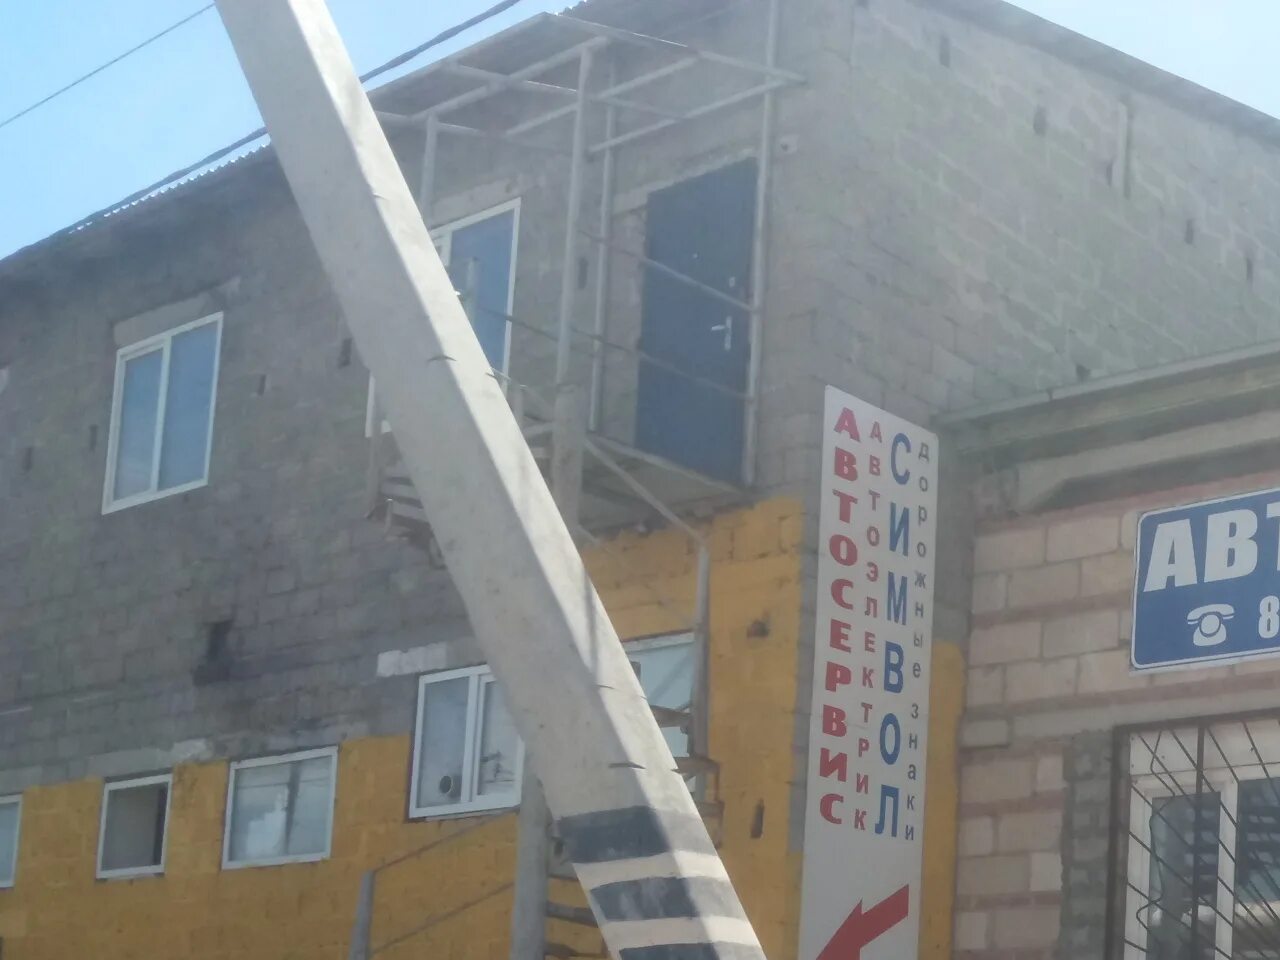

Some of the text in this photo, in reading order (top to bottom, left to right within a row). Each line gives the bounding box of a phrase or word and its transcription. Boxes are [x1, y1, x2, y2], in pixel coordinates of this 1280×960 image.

[819, 407, 861, 825] АВТОСЕРВИС
[854, 421, 883, 831] АВТОЭЛЕКТРИК
[874, 432, 912, 838] СИМВОЛ
[904, 704, 920, 841] знаки
